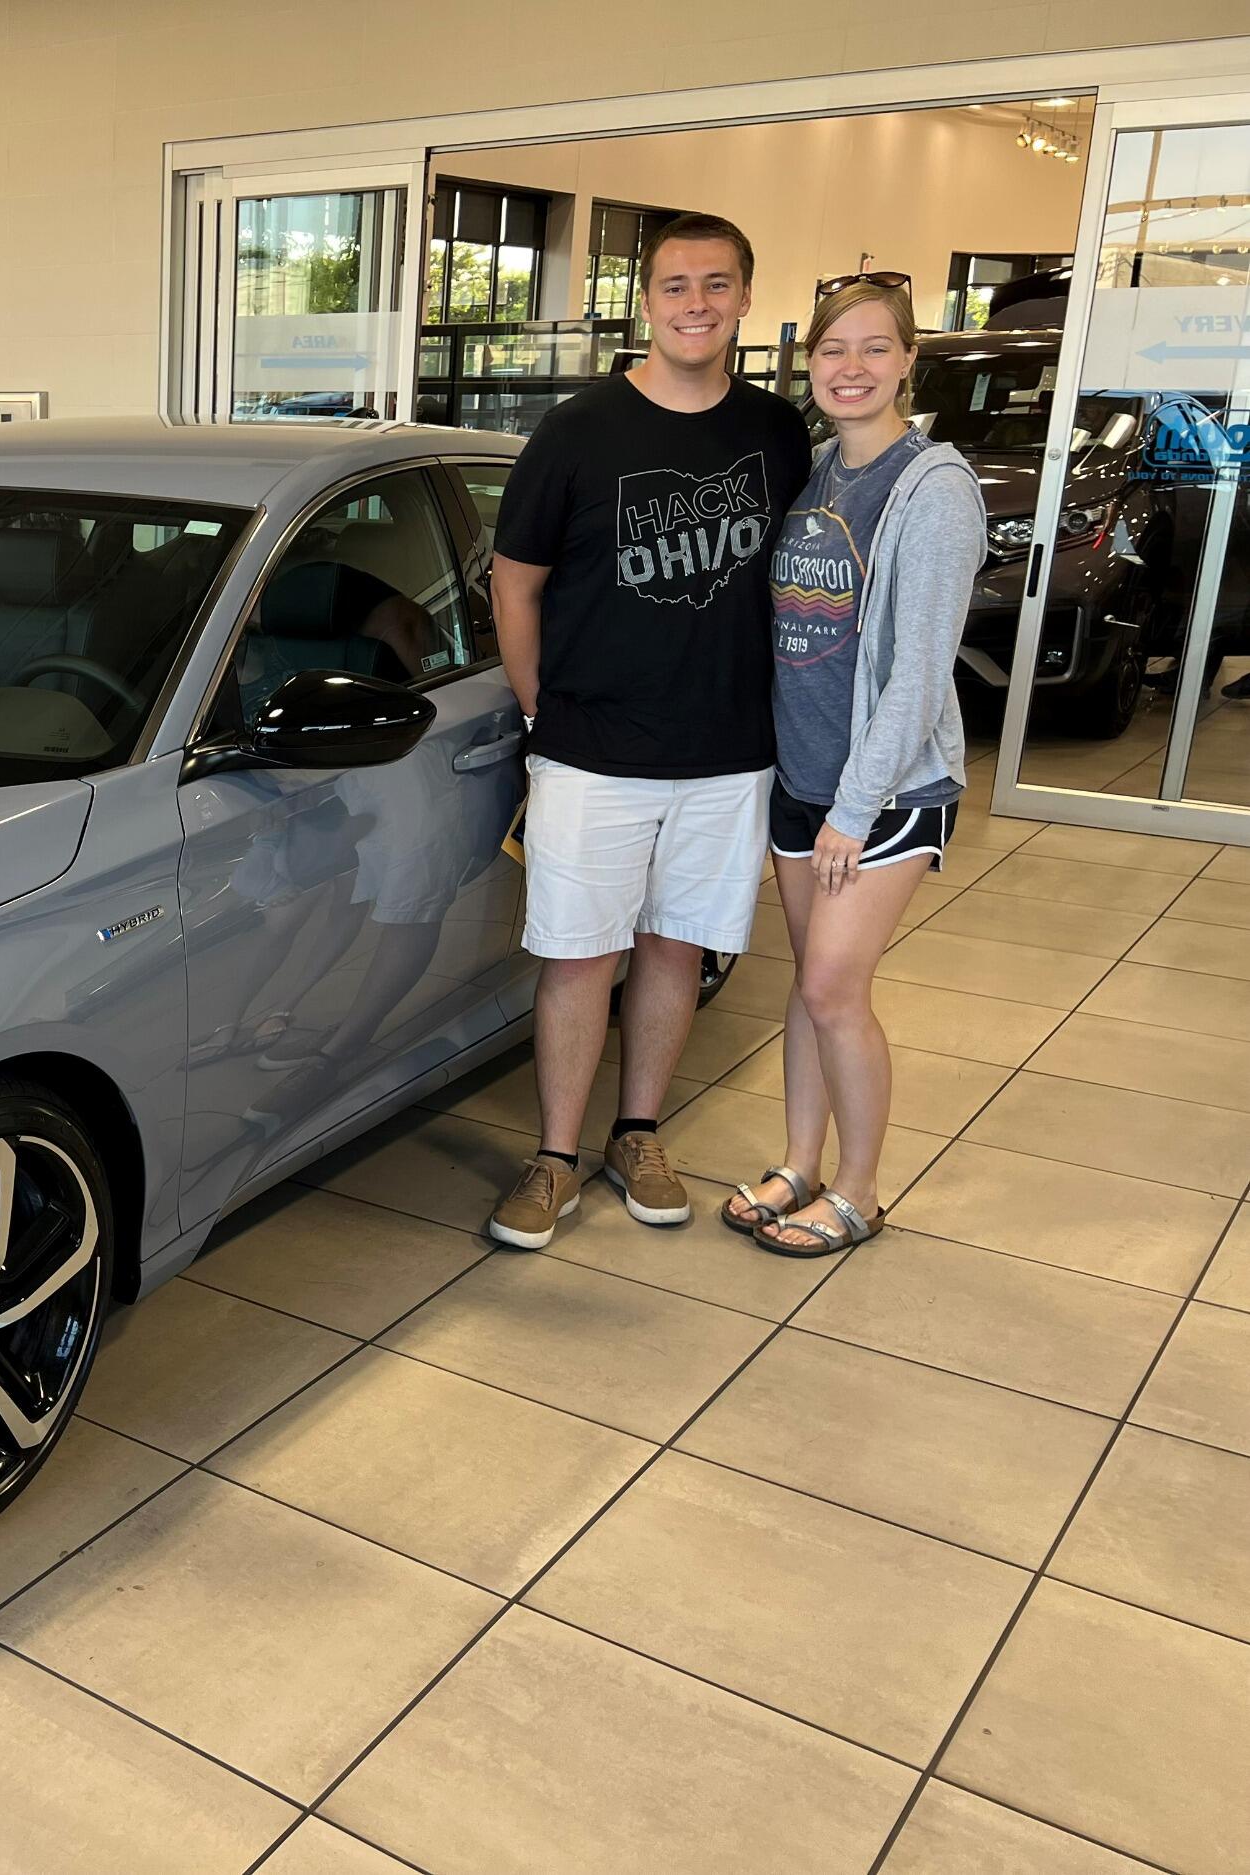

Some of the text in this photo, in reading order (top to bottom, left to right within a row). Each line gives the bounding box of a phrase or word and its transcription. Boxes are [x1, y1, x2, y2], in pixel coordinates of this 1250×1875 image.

[626, 474, 759, 541] HACK
[791, 554, 853, 590] CANYON
[786, 636, 808, 653] 1919
[806, 624, 838, 636] PARK
[110, 907, 161, 936] HYBRID
